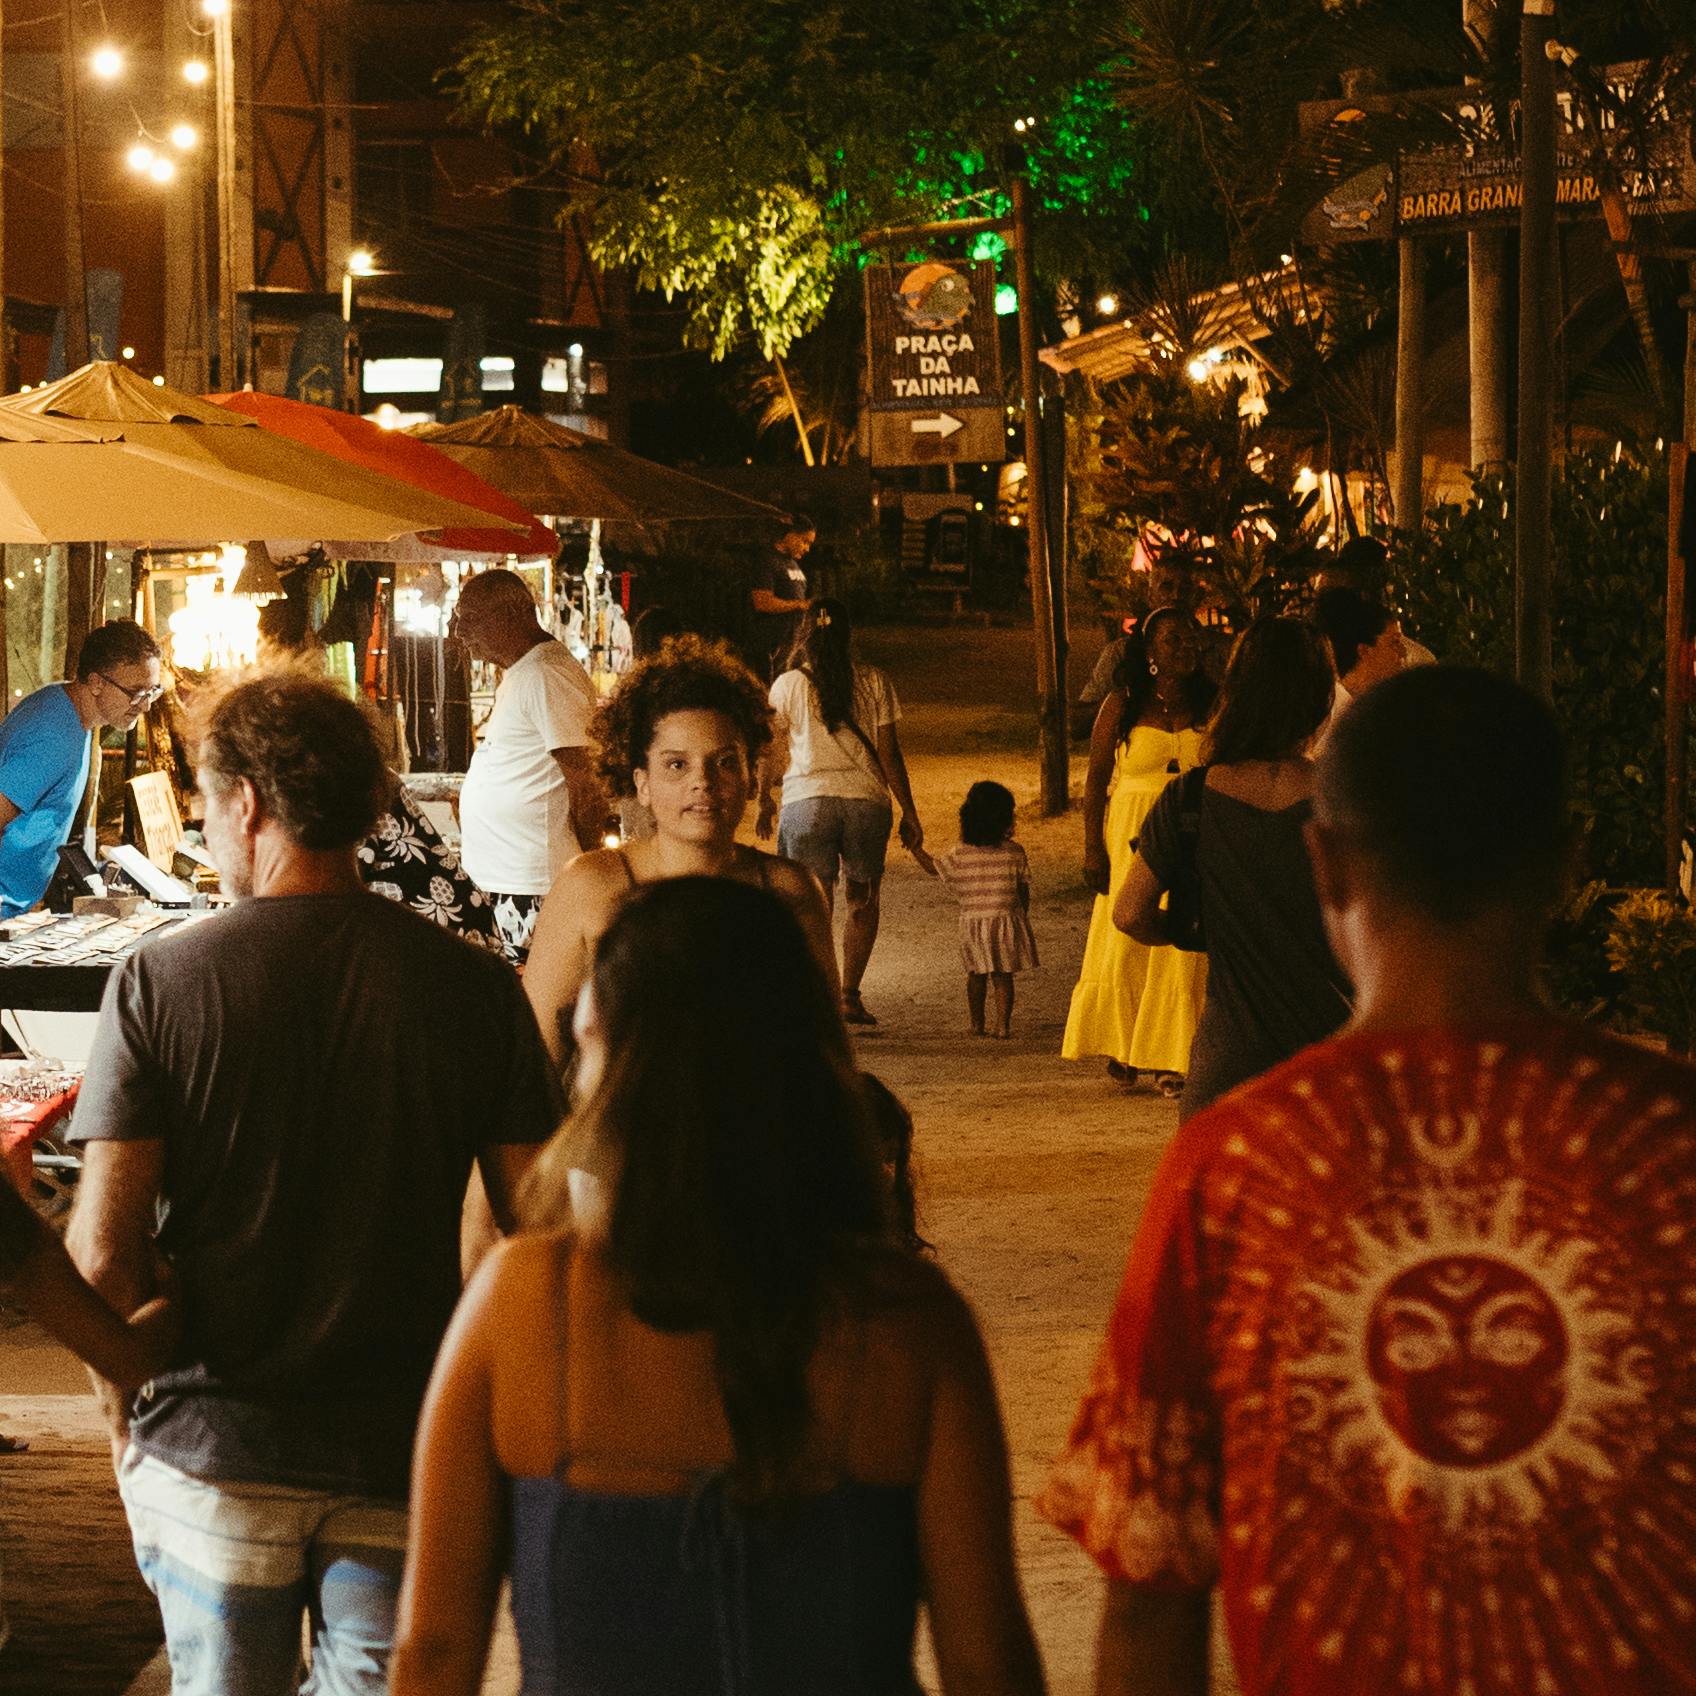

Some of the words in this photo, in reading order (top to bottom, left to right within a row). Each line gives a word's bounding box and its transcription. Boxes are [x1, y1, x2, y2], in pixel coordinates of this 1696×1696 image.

[1401, 190, 1462, 220] BARRA
[895, 333, 975, 357] PRAÇA
[919, 355, 951, 375] DA
[891, 375, 981, 398] TAINHA
